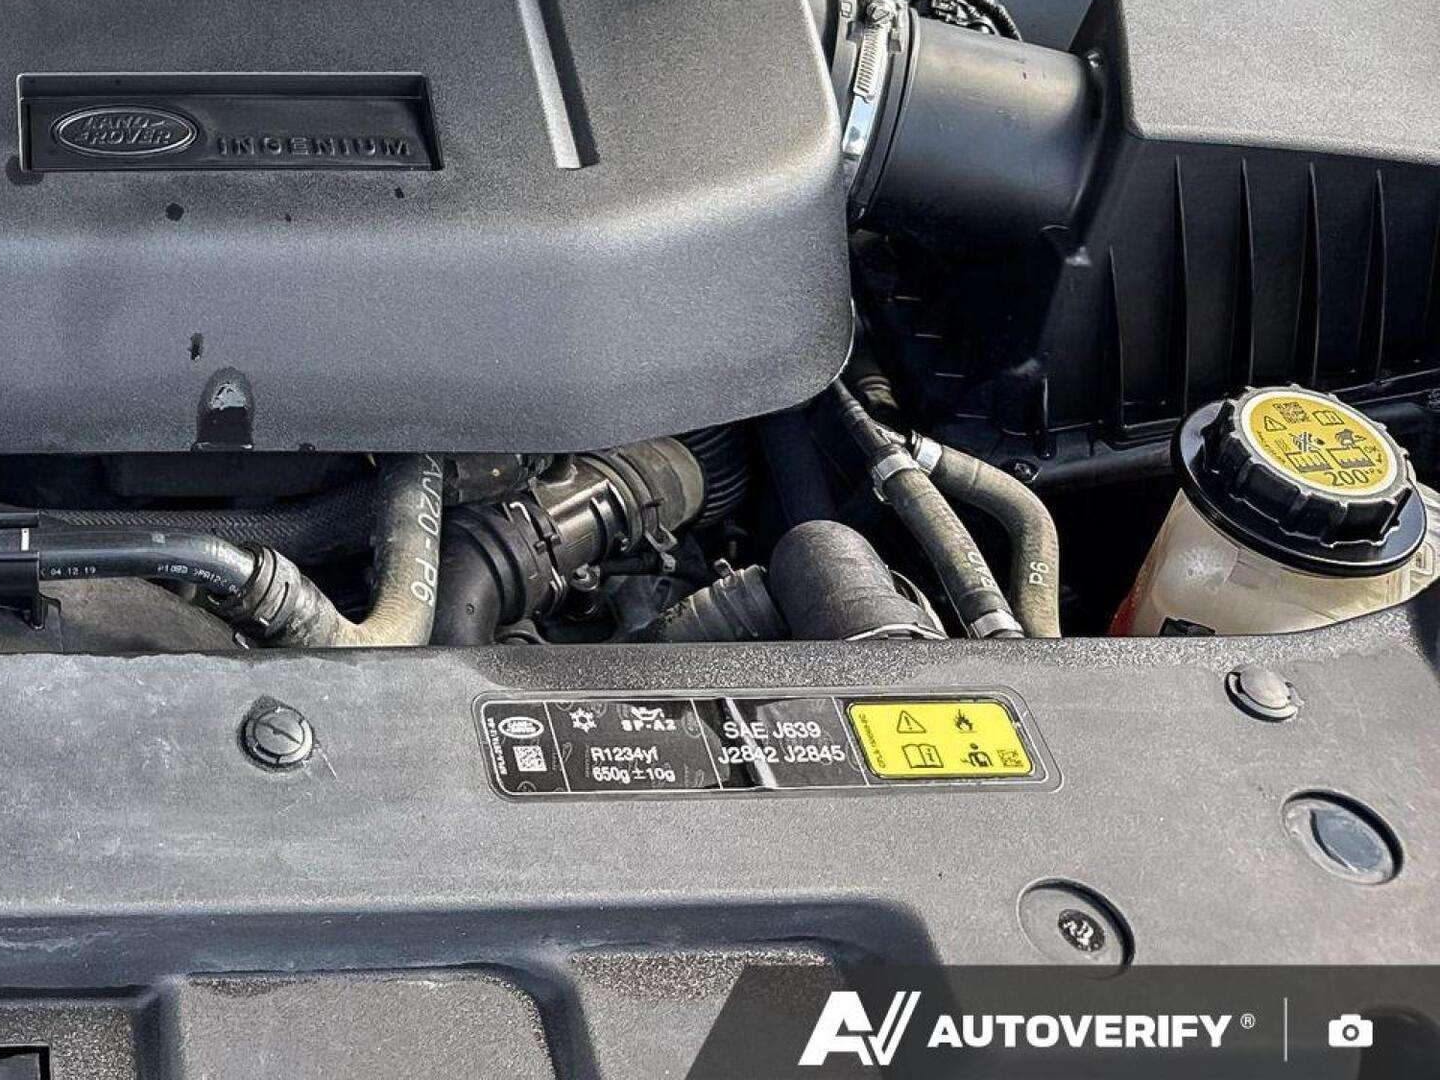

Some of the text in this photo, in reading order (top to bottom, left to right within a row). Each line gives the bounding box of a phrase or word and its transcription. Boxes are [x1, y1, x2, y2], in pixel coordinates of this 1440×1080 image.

[215, 136, 411, 156] INGENIUM
[1324, 470, 1369, 487] 200
[410, 453, 444, 607] AJ20-P6
[1028, 561, 1049, 587] P6
[724, 721, 822, 738] SAE J639
[590, 746, 660, 764] R1234yf
[717, 744, 846, 765] J2842 J2845
[592, 768, 631, 784] 650g
